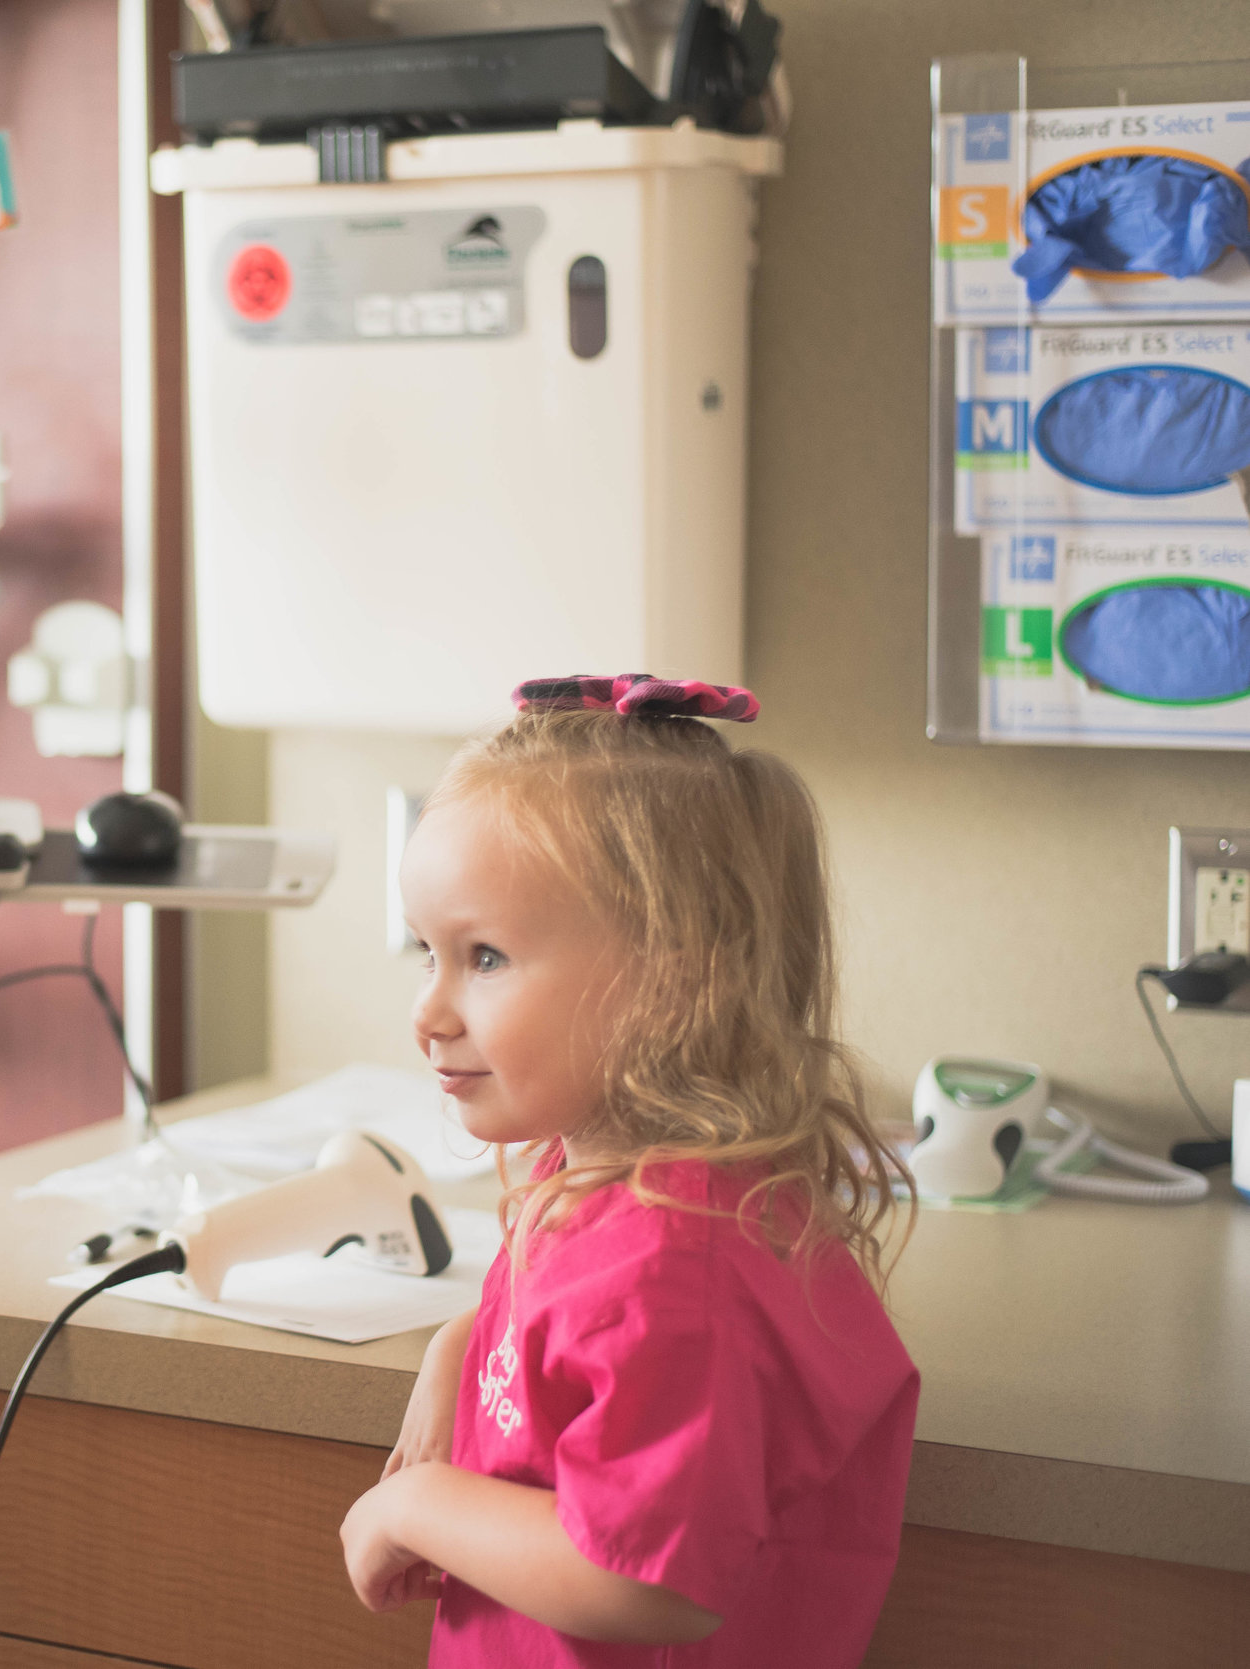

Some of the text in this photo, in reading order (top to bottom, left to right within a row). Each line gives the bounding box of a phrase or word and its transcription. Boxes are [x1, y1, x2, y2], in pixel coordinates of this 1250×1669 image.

[1027, 113, 1214, 141] itGuard ES Select
[957, 192, 989, 238] S
[1142, 332, 1168, 354] ES
[1174, 330, 1235, 354] Select
[971, 403, 1014, 449] M
[1166, 543, 1193, 567] ES
[1198, 543, 1250, 567] Selec
[1004, 609, 1034, 657] L
